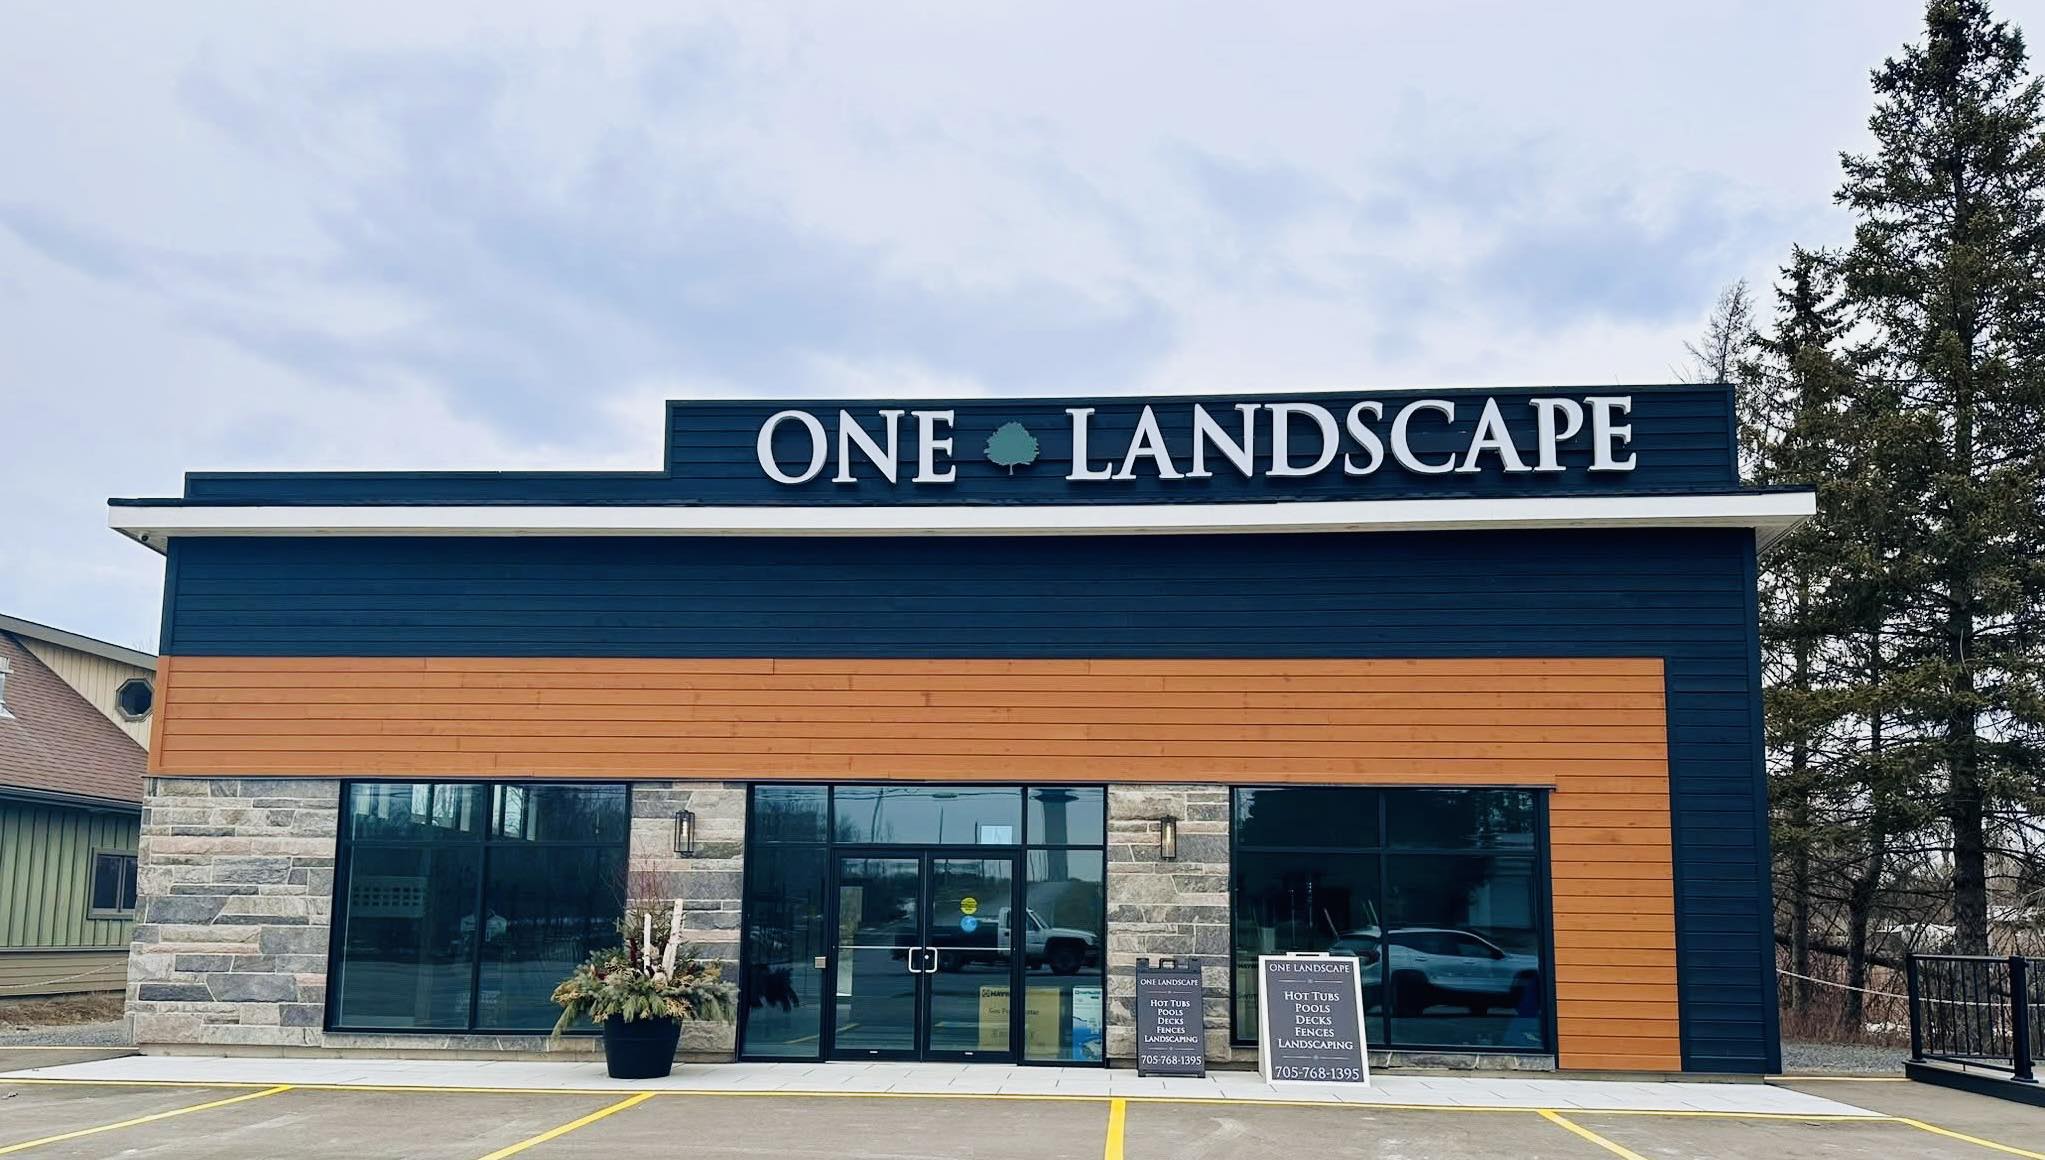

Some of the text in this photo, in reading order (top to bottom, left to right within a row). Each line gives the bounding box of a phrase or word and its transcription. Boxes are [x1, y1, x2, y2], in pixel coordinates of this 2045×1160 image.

[757, 395, 1637, 484] ONE LANDSCAPE
[1269, 963, 1350, 973] ONE LANDSCAPE
[1141, 1055, 1202, 1065] 705-768-1395
[1275, 1066, 1360, 1080] 705-768-1395
